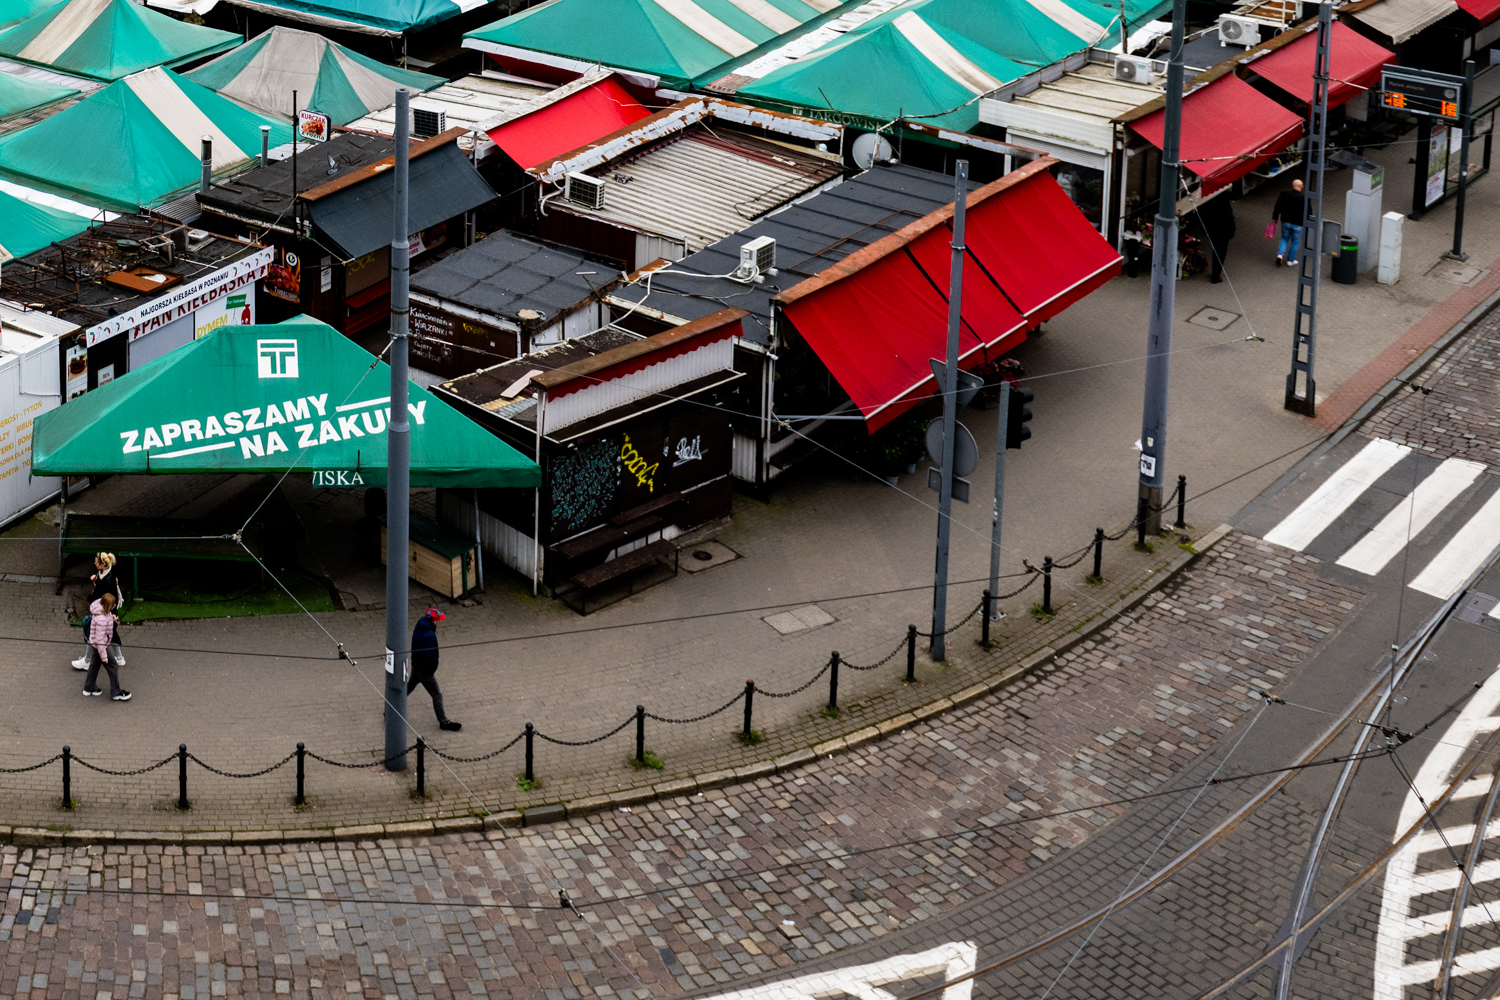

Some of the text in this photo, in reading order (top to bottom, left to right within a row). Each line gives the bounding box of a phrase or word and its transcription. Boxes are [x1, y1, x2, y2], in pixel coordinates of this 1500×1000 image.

[301, 113, 326, 123] KURCZAK
[809, 109, 895, 135] TARGOWISKA
[140, 271, 229, 318] NAJGORSZA KIEŁBASA W POZNANIU
[142, 309, 172, 334] PAN
[197, 313, 228, 339] DYMEM
[119, 393, 329, 455] ZAPRASZAMY
[239, 400, 427, 460] NA ZAKUY
[14, 449, 24, 460] DLA
